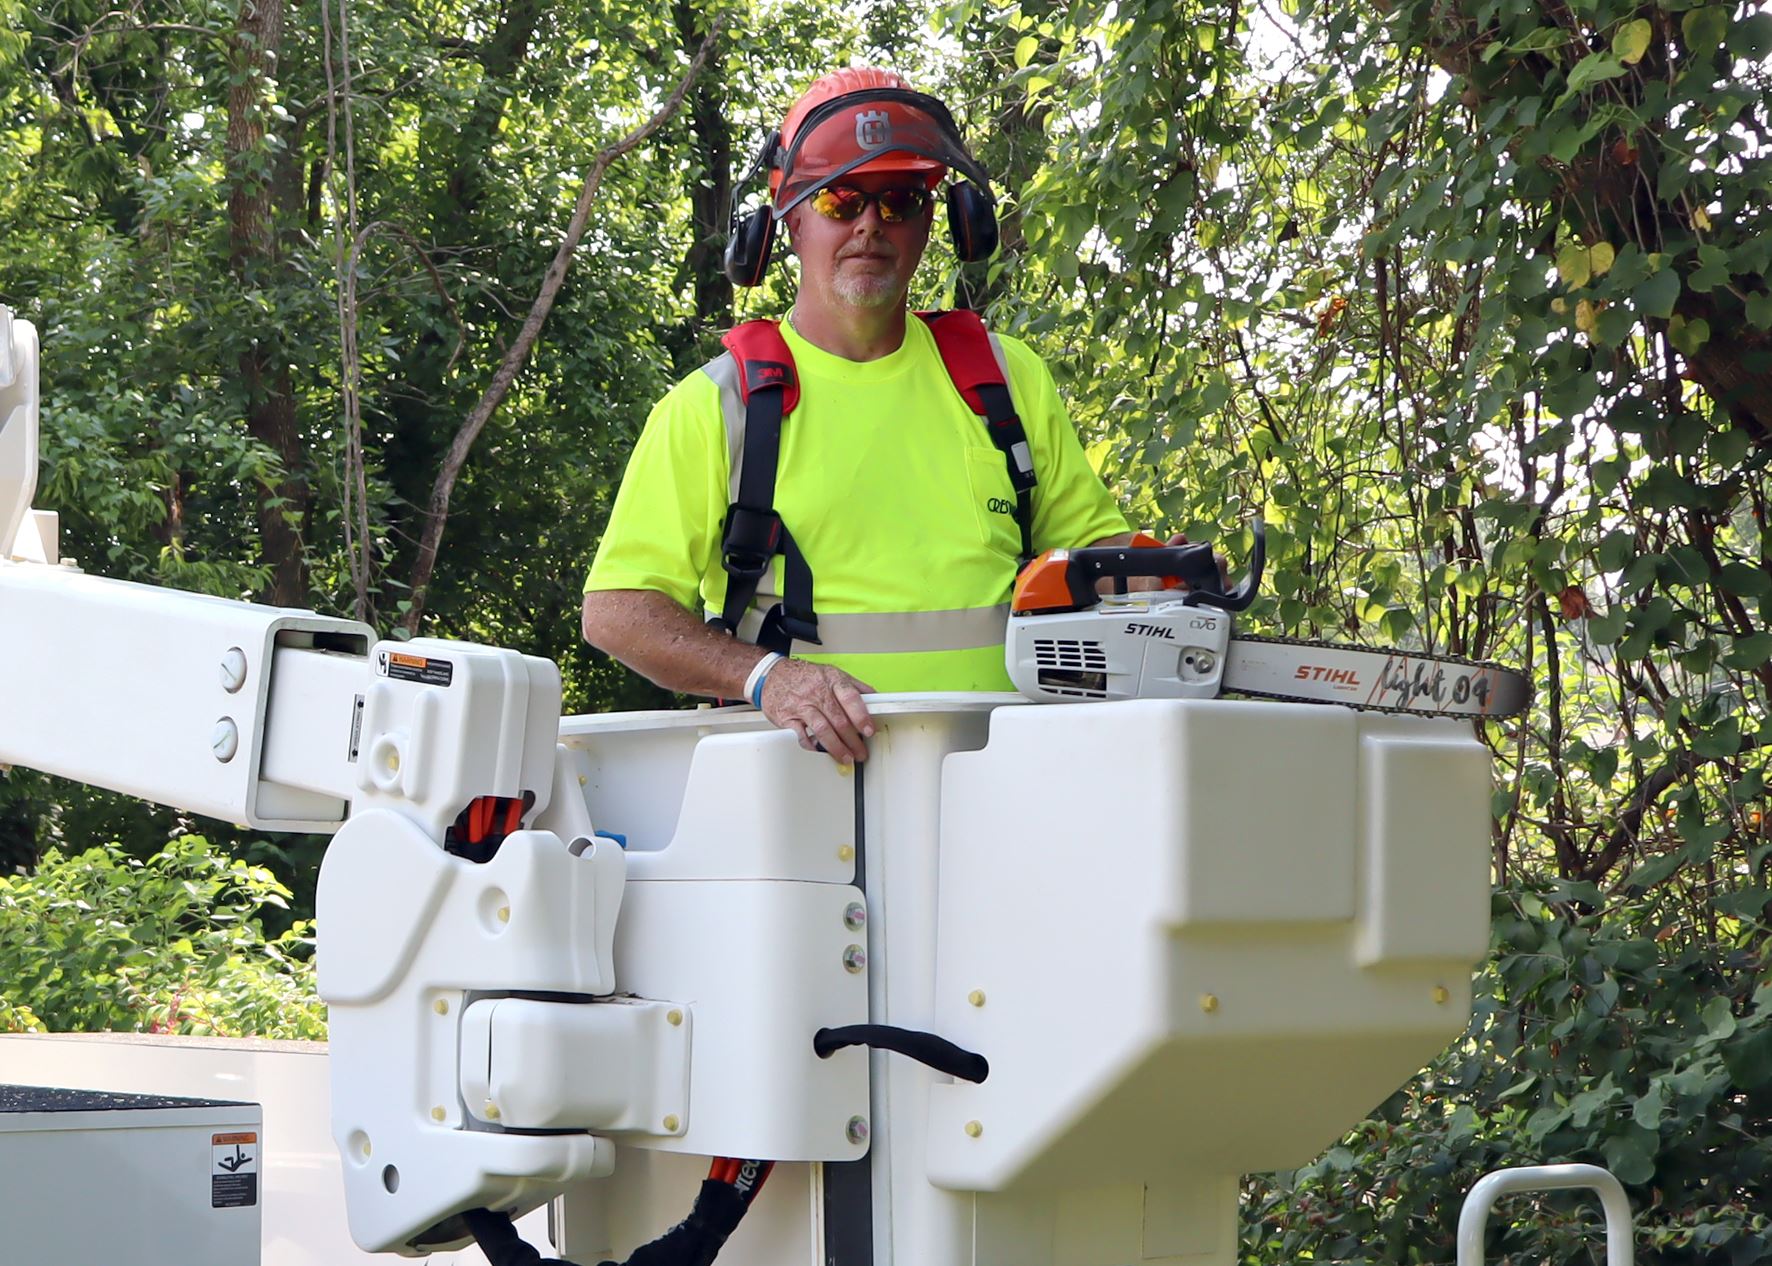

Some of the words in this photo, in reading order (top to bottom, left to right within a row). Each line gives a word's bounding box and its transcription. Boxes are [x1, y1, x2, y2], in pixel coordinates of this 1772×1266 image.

[756, 367, 784, 380] 3M
[1124, 623, 1175, 639] STIHL
[1294, 665, 1360, 685] STIHL
[1453, 675, 1490, 707] 04
